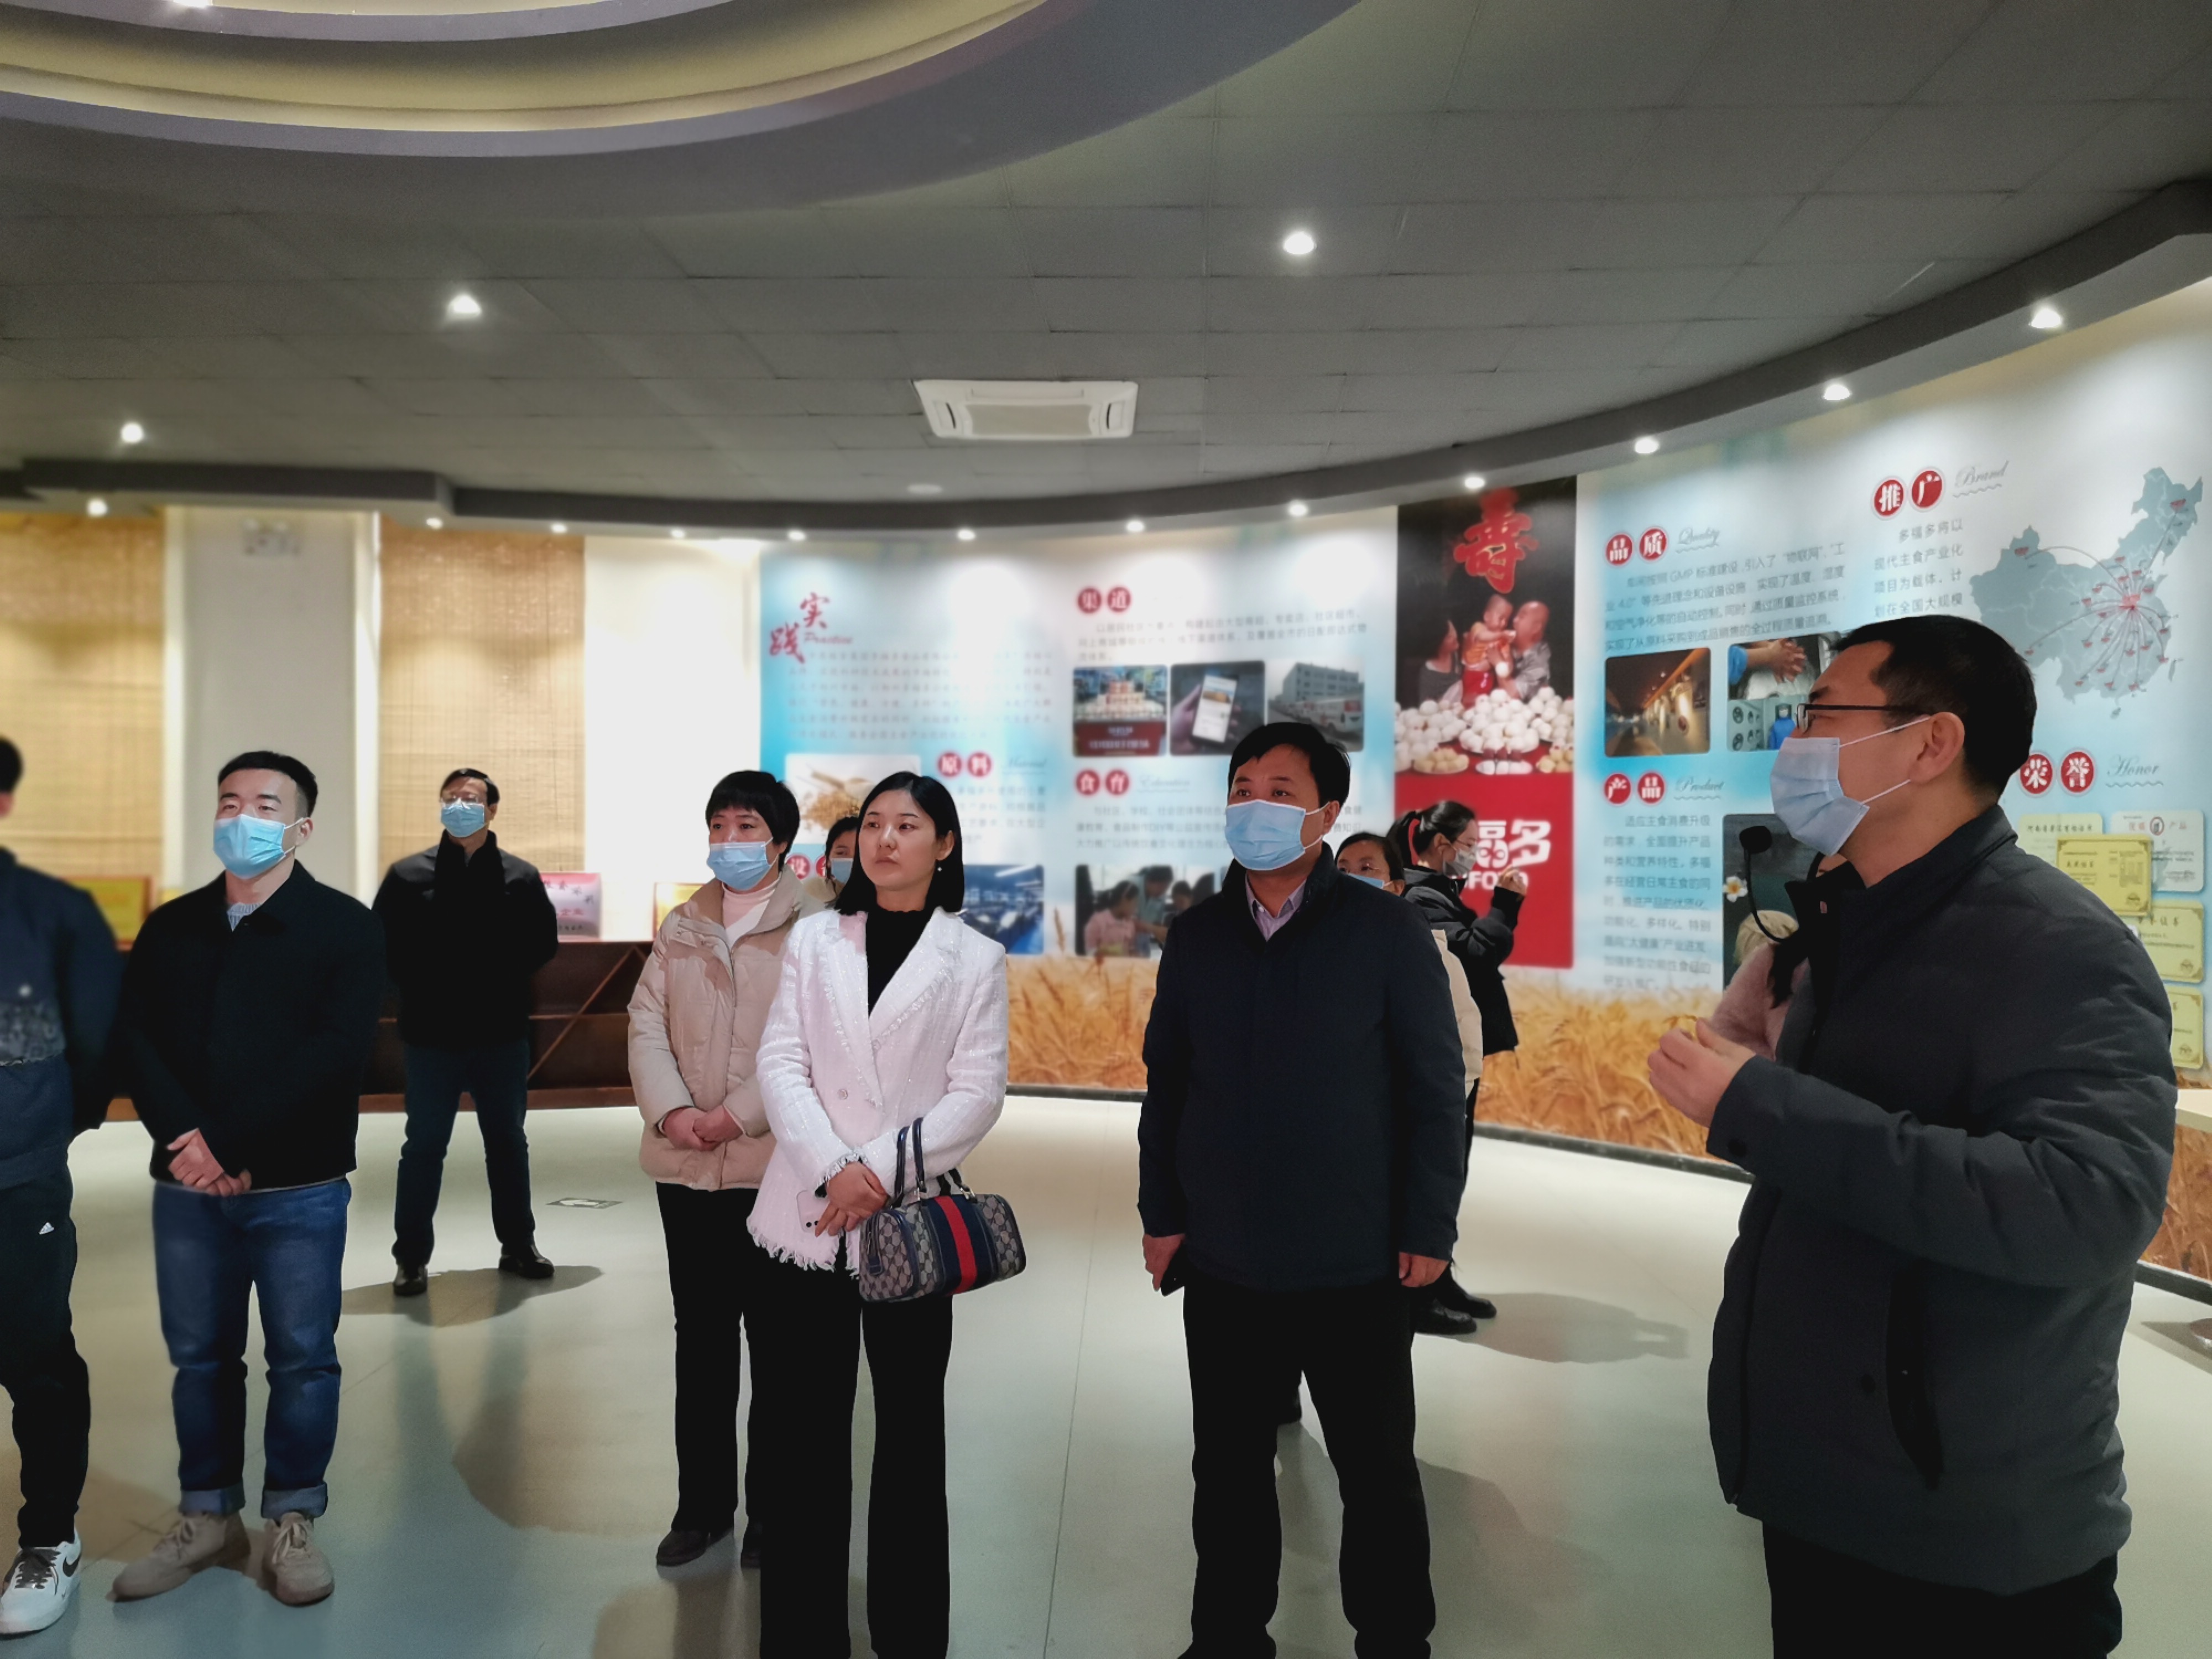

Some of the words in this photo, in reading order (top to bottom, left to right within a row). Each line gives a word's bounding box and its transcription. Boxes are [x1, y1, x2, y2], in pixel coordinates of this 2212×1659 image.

[1954, 460, 2010, 487] Brand
[1878, 472, 1940, 513] 推广
[1609, 531, 1663, 562] 品质
[1678, 527, 1720, 545] Quality
[1081, 589, 1129, 611] 渠道
[769, 592, 830, 663] 实践
[941, 755, 988, 774] 原料
[2023, 757, 2090, 789] 荣誉
[2106, 754, 2159, 775] Honor
[1608, 776, 1661, 800] 产品
[1674, 776, 1726, 791] Product
